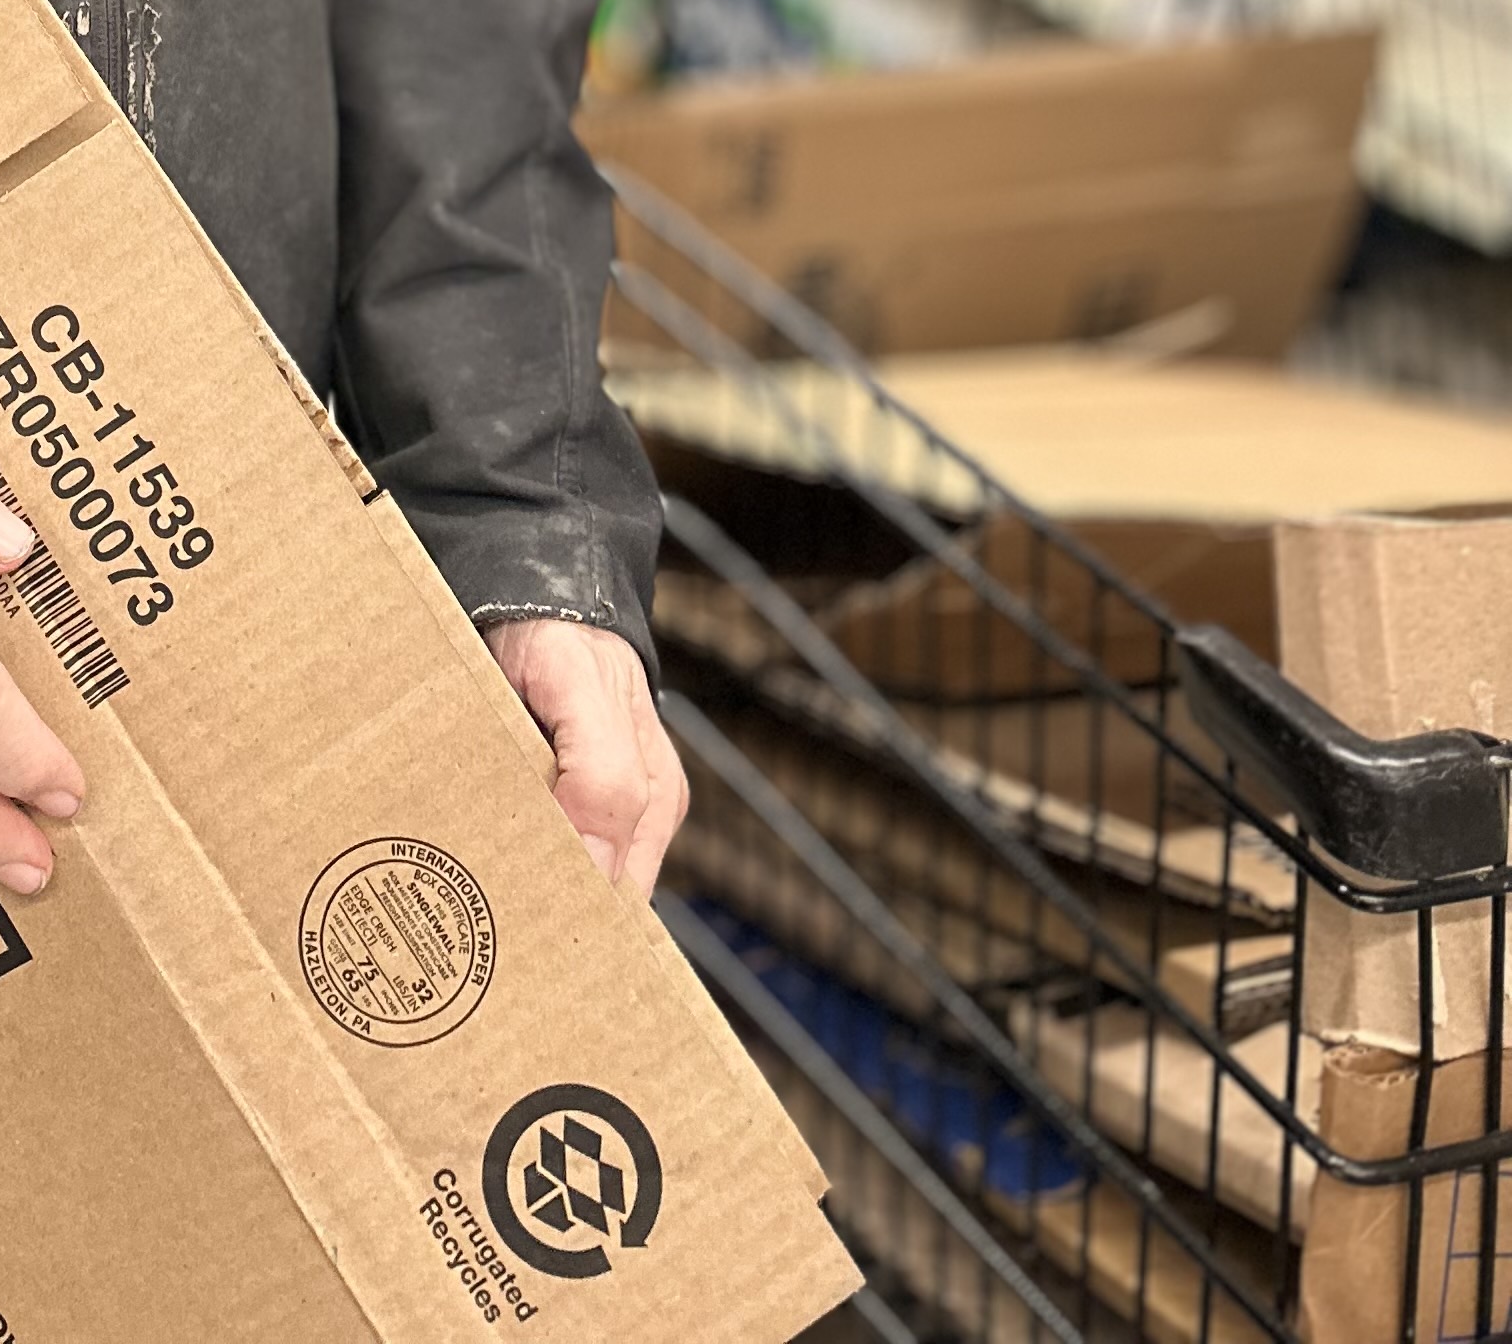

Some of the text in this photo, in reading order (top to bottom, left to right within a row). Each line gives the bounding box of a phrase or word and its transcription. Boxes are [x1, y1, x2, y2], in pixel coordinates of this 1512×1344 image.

[31, 305, 214, 569] CB-11539
[341, 891, 378, 946] TEST (ECT)
[350, 884, 397, 952] EDGE CRUSH
[392, 843, 490, 986] INTERNATIONAL PAPER
[407, 882, 455, 955] SINGLEWALL
[414, 869, 469, 954] BOX CERTIFICATE
[434, 903, 446, 920] THIS
[305, 931, 370, 1034] HAZLETON, PA
[342, 969, 364, 992] 65
[357, 956, 379, 981] 75
[393, 975, 420, 1013] LBS/IN
[412, 978, 433, 1005] 32
[419, 1196, 501, 1324] Recycles
[433, 1168, 538, 1323] Corrugated
